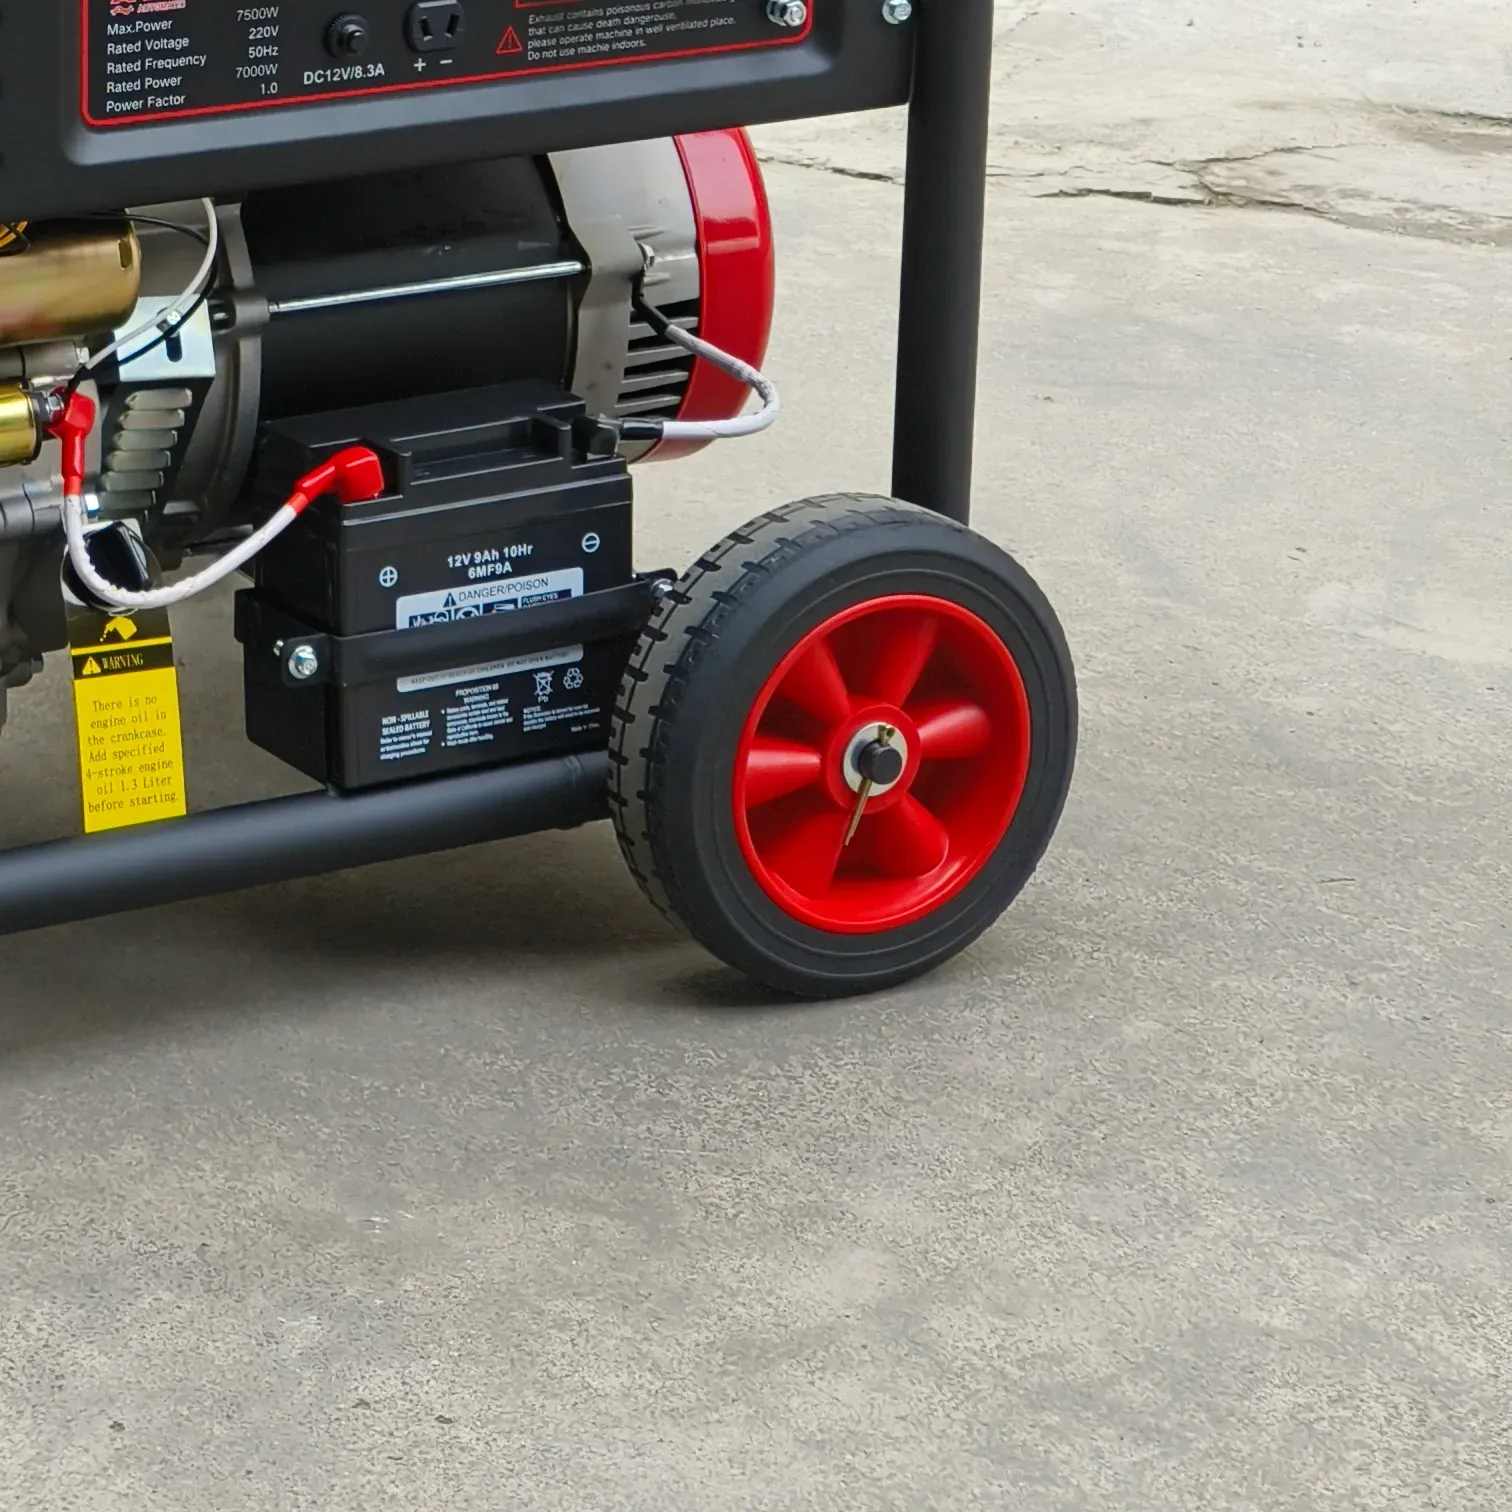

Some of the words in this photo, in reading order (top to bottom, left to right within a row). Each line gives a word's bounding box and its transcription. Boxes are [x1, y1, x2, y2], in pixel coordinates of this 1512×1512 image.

[236, 6, 279, 22] 7500W
[106, 19, 173, 36] Max.Power
[248, 25, 279, 39] 220V
[528, 25, 547, 36] that
[549, 26, 565, 34] can
[567, 22, 594, 31] cause
[596, 18, 622, 29] death
[528, 39, 557, 50] please
[559, 34, 594, 46] operate
[595, 29, 633, 40] machine
[645, 24, 663, 33] well
[710, 16, 737, 28] place.
[106, 40, 141, 55] Rated
[145, 37, 190, 51] Voltage
[248, 45, 279, 58] 50Hz
[528, 51, 540, 61] Do
[542, 48, 557, 58] not
[559, 48, 576, 57] use
[106, 60, 141, 74] Rated
[145, 54, 207, 70] Frequency
[235, 63, 278, 79] 7000W
[303, 63, 386, 85] DC12V/8.3A
[106, 79, 141, 94] Rated
[145, 76, 183, 89] Power
[260, 82, 278, 95] 1.0
[106, 98, 144, 113] Power
[147, 94, 187, 108] Factor
[447, 553, 471, 568] 12V
[473, 550, 499, 565] 9Ah
[503, 543, 533, 559] 10Hr
[468, 563, 513, 580] 6MF9A
[458, 577, 549, 602] DANGER/POISON
[102, 653, 144, 670] WARNING
[93, 700, 122, 712] There
[129, 696, 139, 707] is
[145, 696, 157, 705] no
[91, 715, 126, 729] engine
[132, 709, 148, 723] oil
[156, 709, 167, 720] in
[88, 730, 104, 745] the
[111, 728, 166, 743] crankcase.
[89, 749, 107, 762] Add
[113, 742, 165, 760] specified
[86, 765, 133, 779] 4-stroke
[139, 759, 173, 773] engine
[97, 782, 113, 795] oil
[144, 776, 172, 788] Liter
[88, 800, 124, 813] before
[129, 792, 179, 807] starting.
